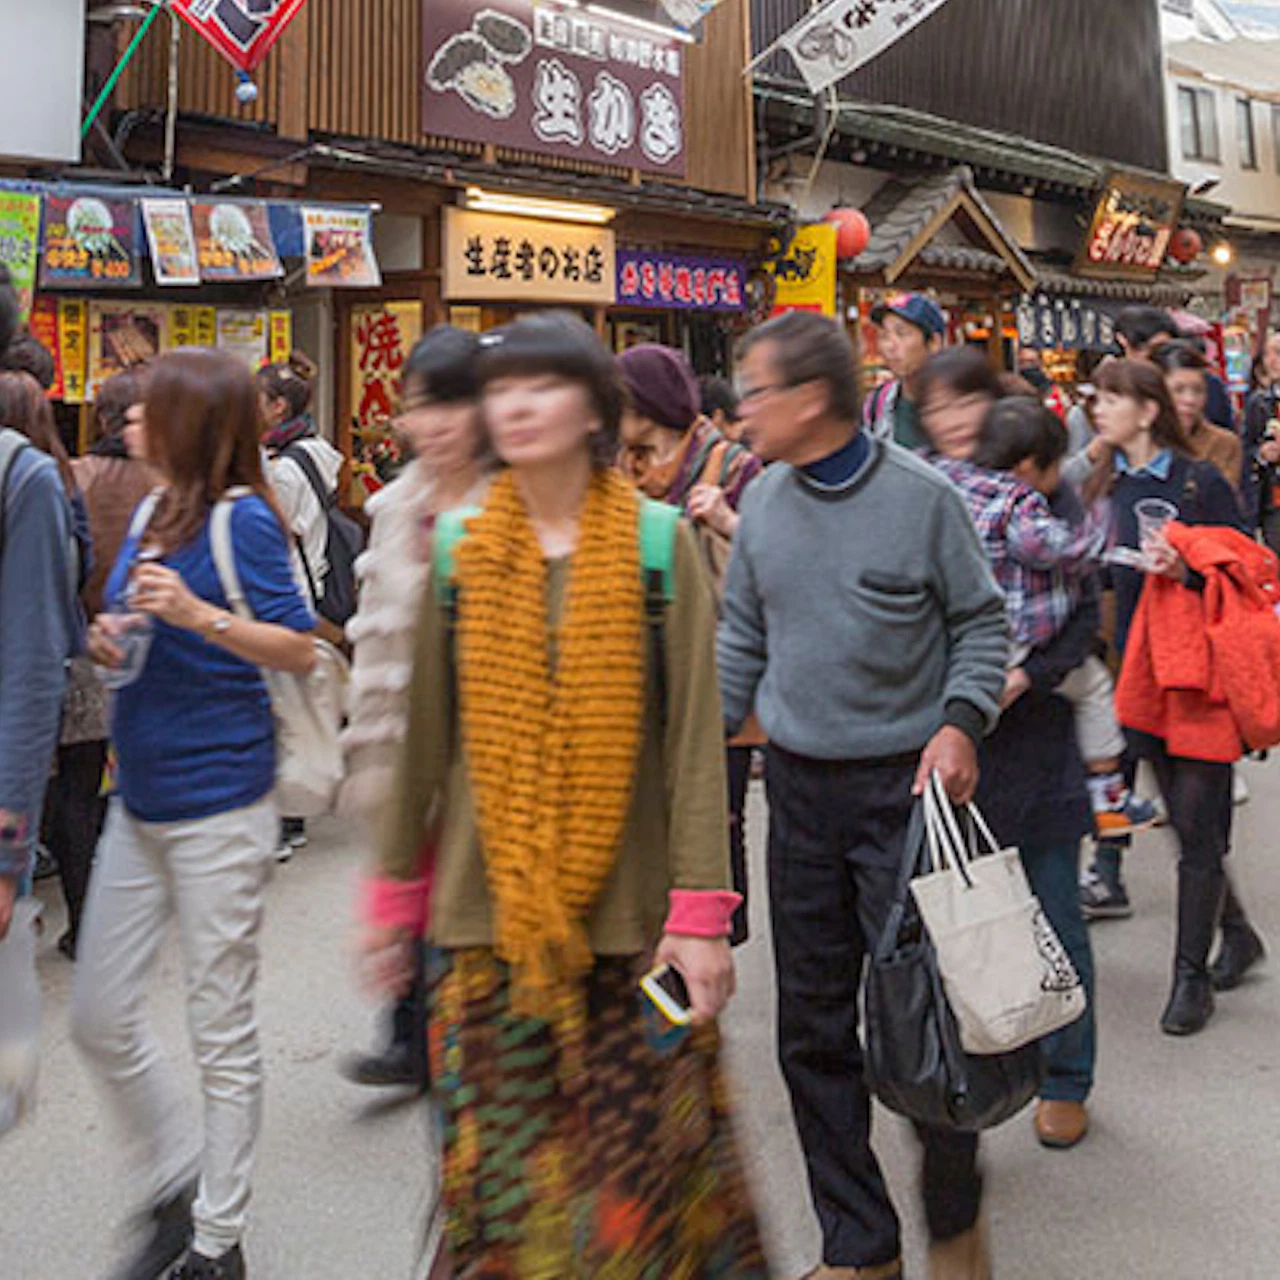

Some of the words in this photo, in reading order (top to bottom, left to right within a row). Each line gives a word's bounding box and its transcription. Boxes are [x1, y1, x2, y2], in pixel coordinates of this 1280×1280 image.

[532, 58, 682, 164] 生かき
[463, 234, 606, 284] 生産者のお店
